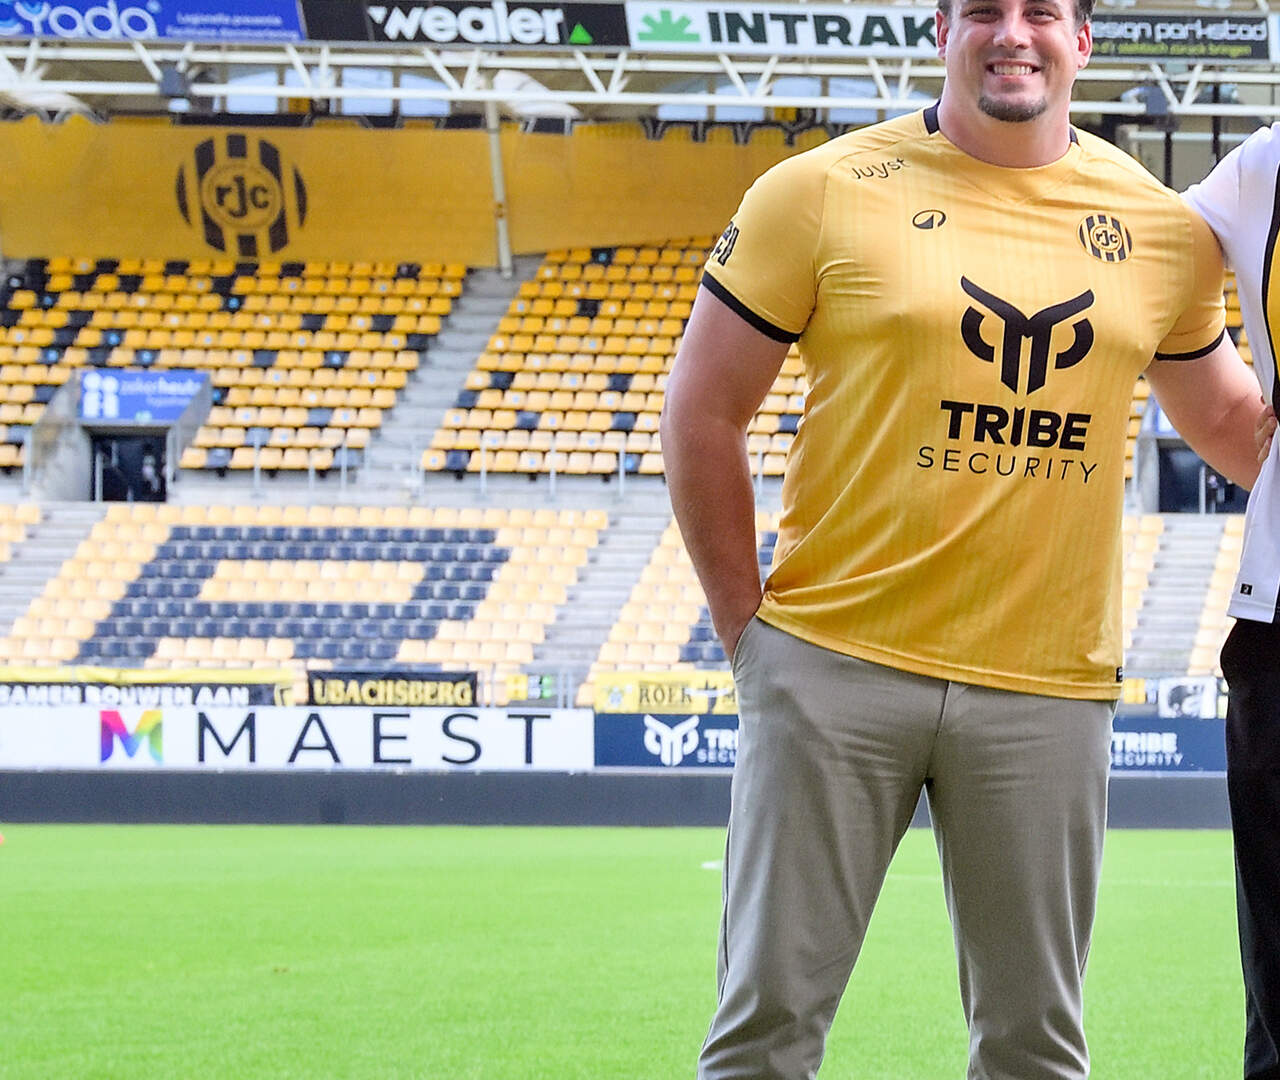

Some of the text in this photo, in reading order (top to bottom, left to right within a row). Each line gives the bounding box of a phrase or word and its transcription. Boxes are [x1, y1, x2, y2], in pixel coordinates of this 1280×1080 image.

[940, 400, 1092, 451] TRIBE
[917, 446, 1097, 484] SECURITY
[197, 712, 551, 765] MAEST
[1111, 752, 1184, 767] ECURITY
